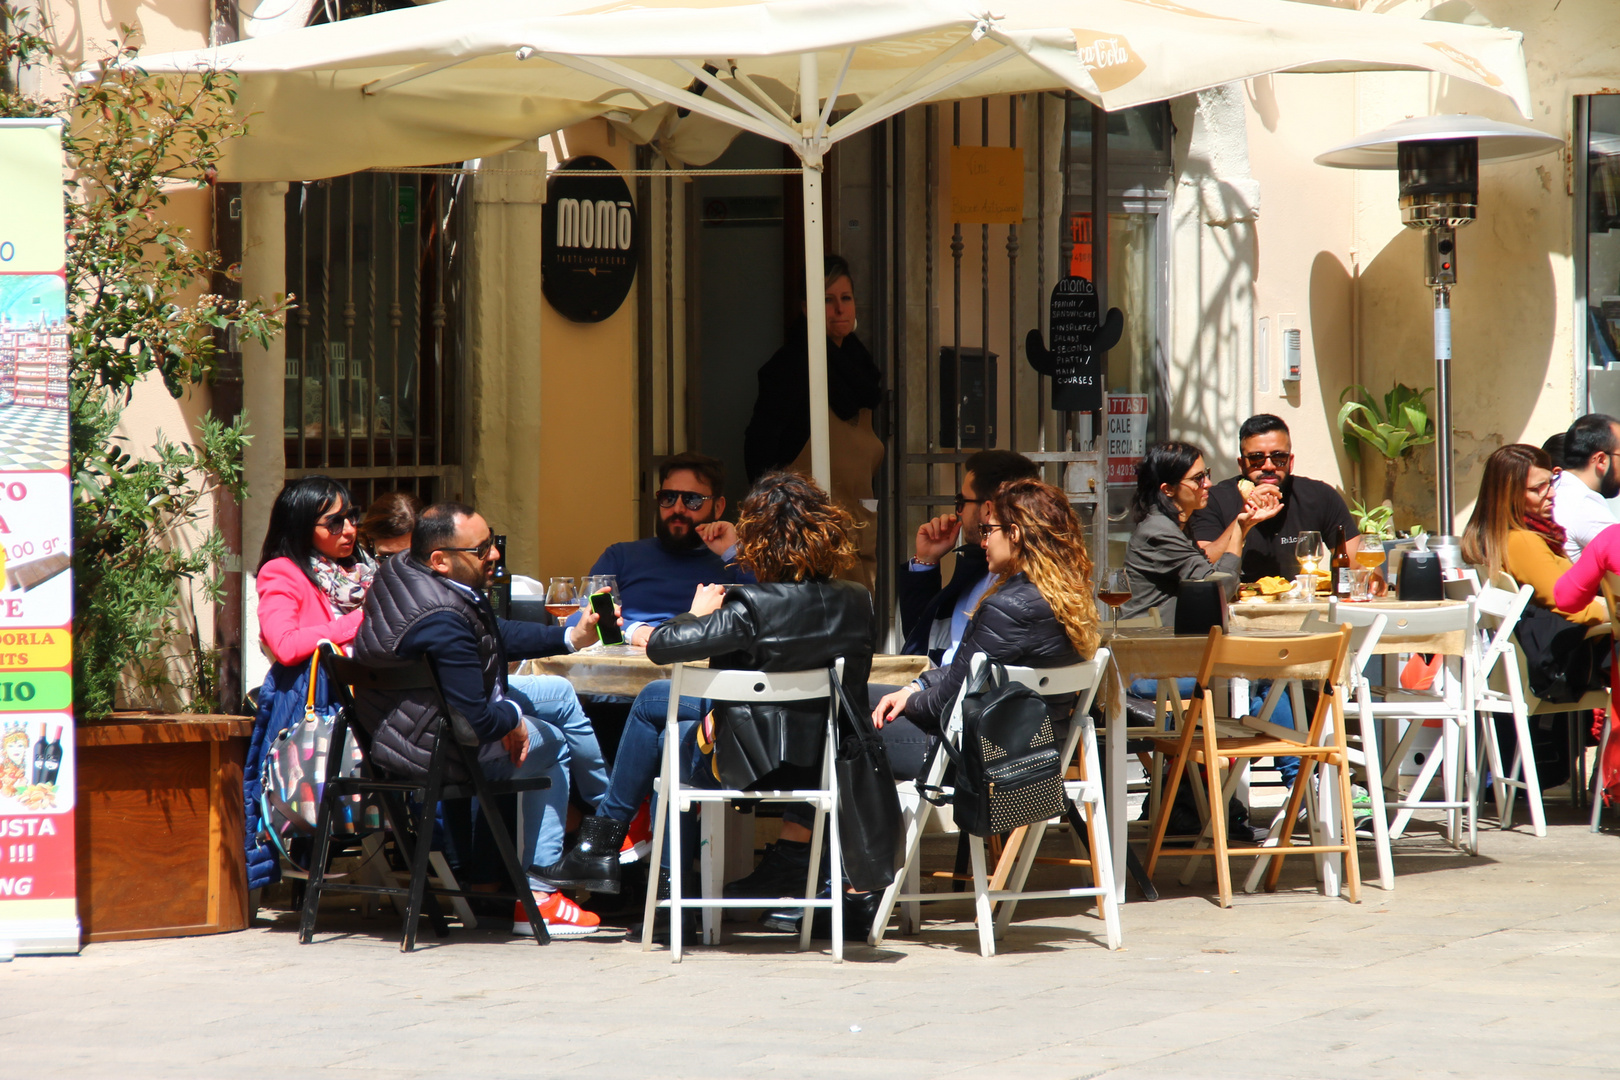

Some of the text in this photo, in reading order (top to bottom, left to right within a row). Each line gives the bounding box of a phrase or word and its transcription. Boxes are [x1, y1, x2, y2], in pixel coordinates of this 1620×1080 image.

[1058, 376, 1093, 386] COURSES
[0, 481, 27, 502] O
[0, 632, 55, 645] ORLA
[0, 681, 35, 702] IO
